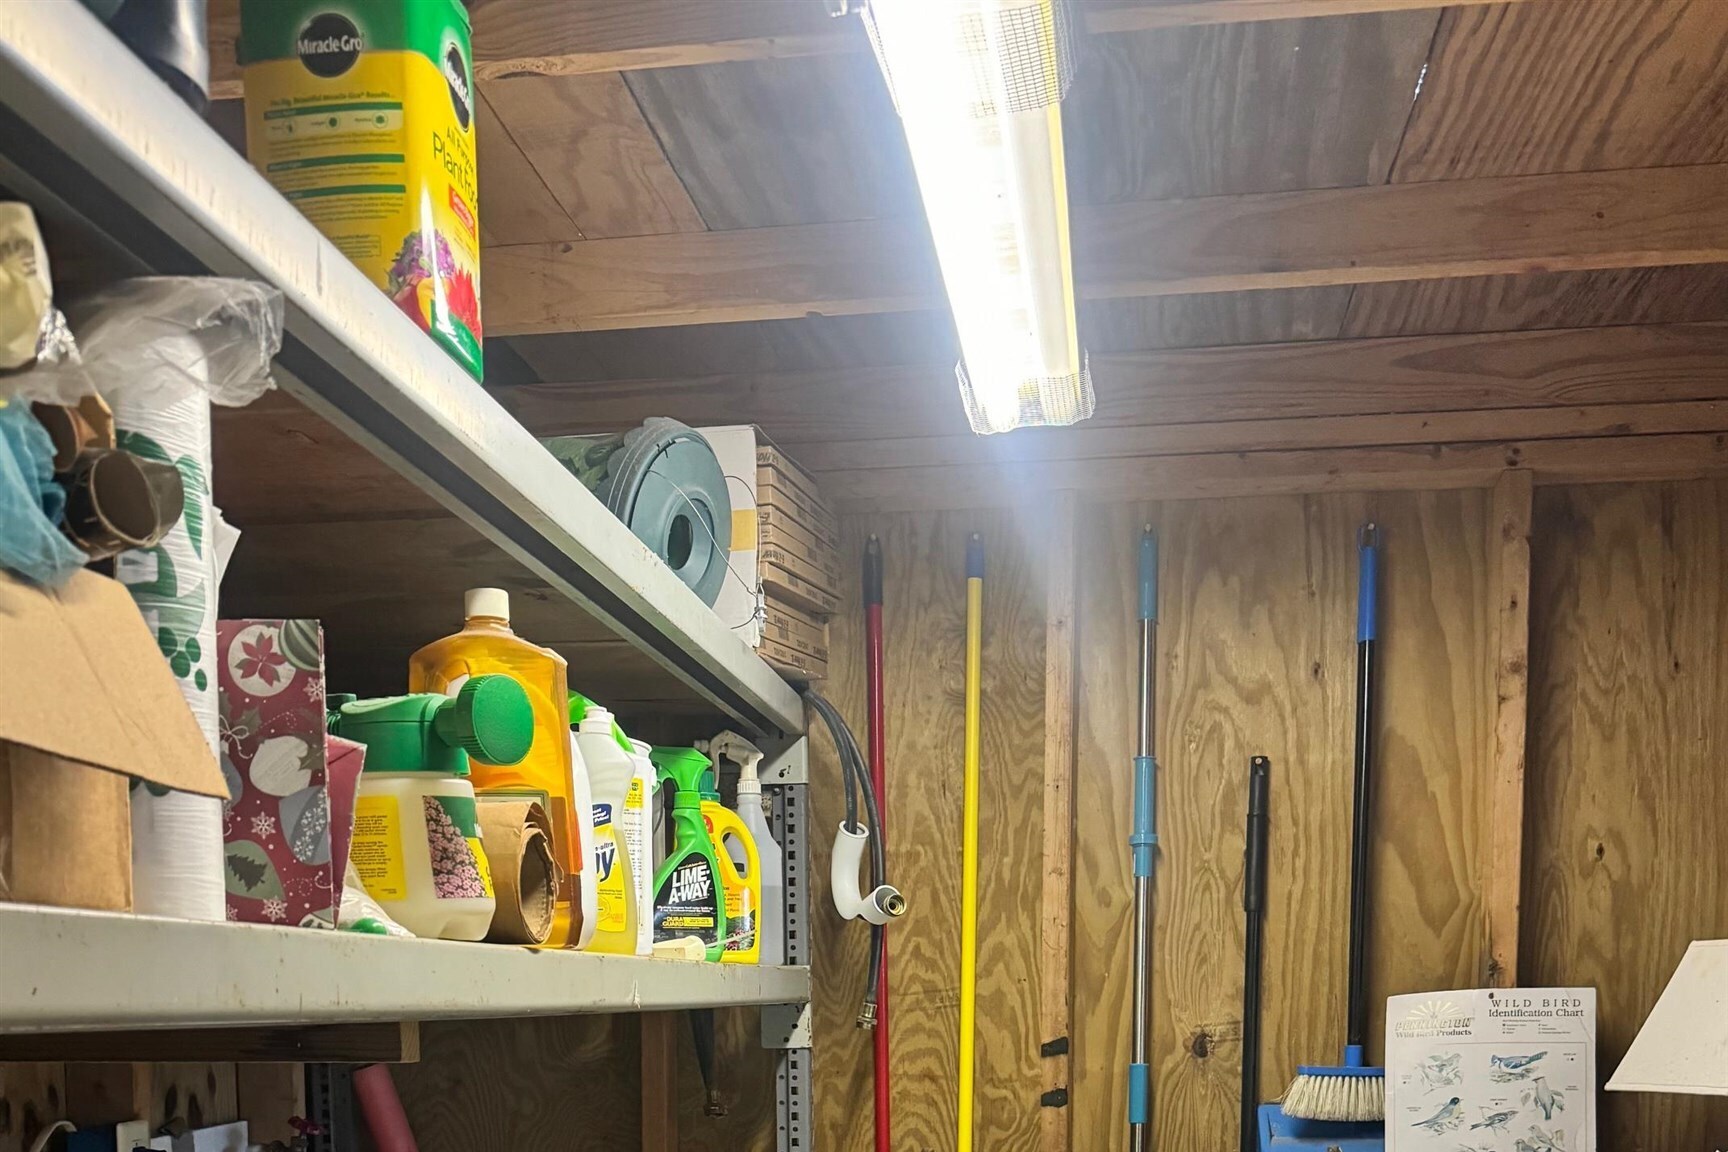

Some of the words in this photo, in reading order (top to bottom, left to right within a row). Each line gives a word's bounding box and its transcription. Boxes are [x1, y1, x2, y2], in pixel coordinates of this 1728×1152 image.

[432, 130, 464, 190] Plant
[1491, 999, 1532, 1007] WILD
[1542, 999, 1581, 1007] BIRD
[1488, 1008, 1553, 1017] Identification
[1556, 1008, 1584, 1017] Chart
[1395, 1031, 1415, 1039] Wild
[1436, 1029, 1472, 1037] Products
